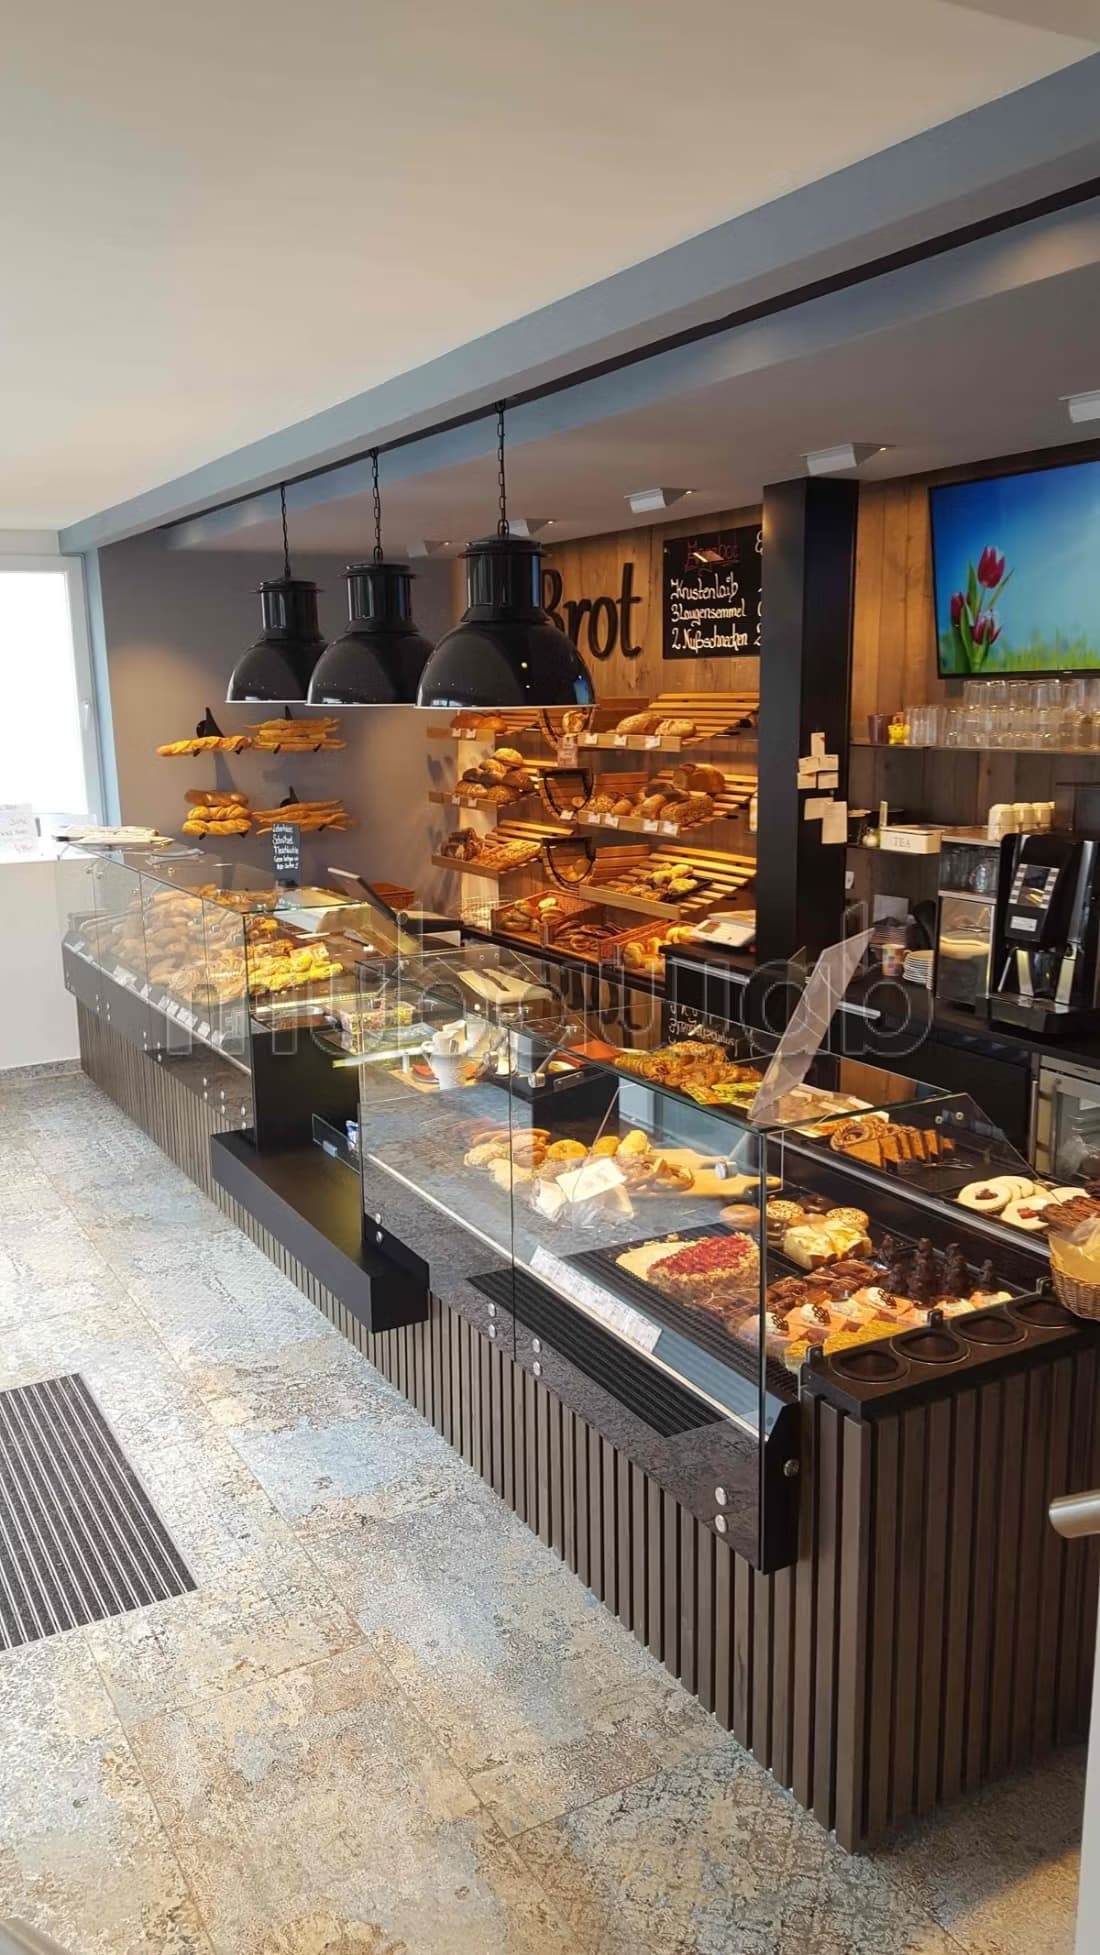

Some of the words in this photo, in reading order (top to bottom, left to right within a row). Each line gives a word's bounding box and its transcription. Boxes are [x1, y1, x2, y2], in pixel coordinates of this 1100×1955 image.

[670, 570, 739, 603] Krustenlaib
[542, 562, 643, 661] Brot
[893, 836, 912, 848] TEA
